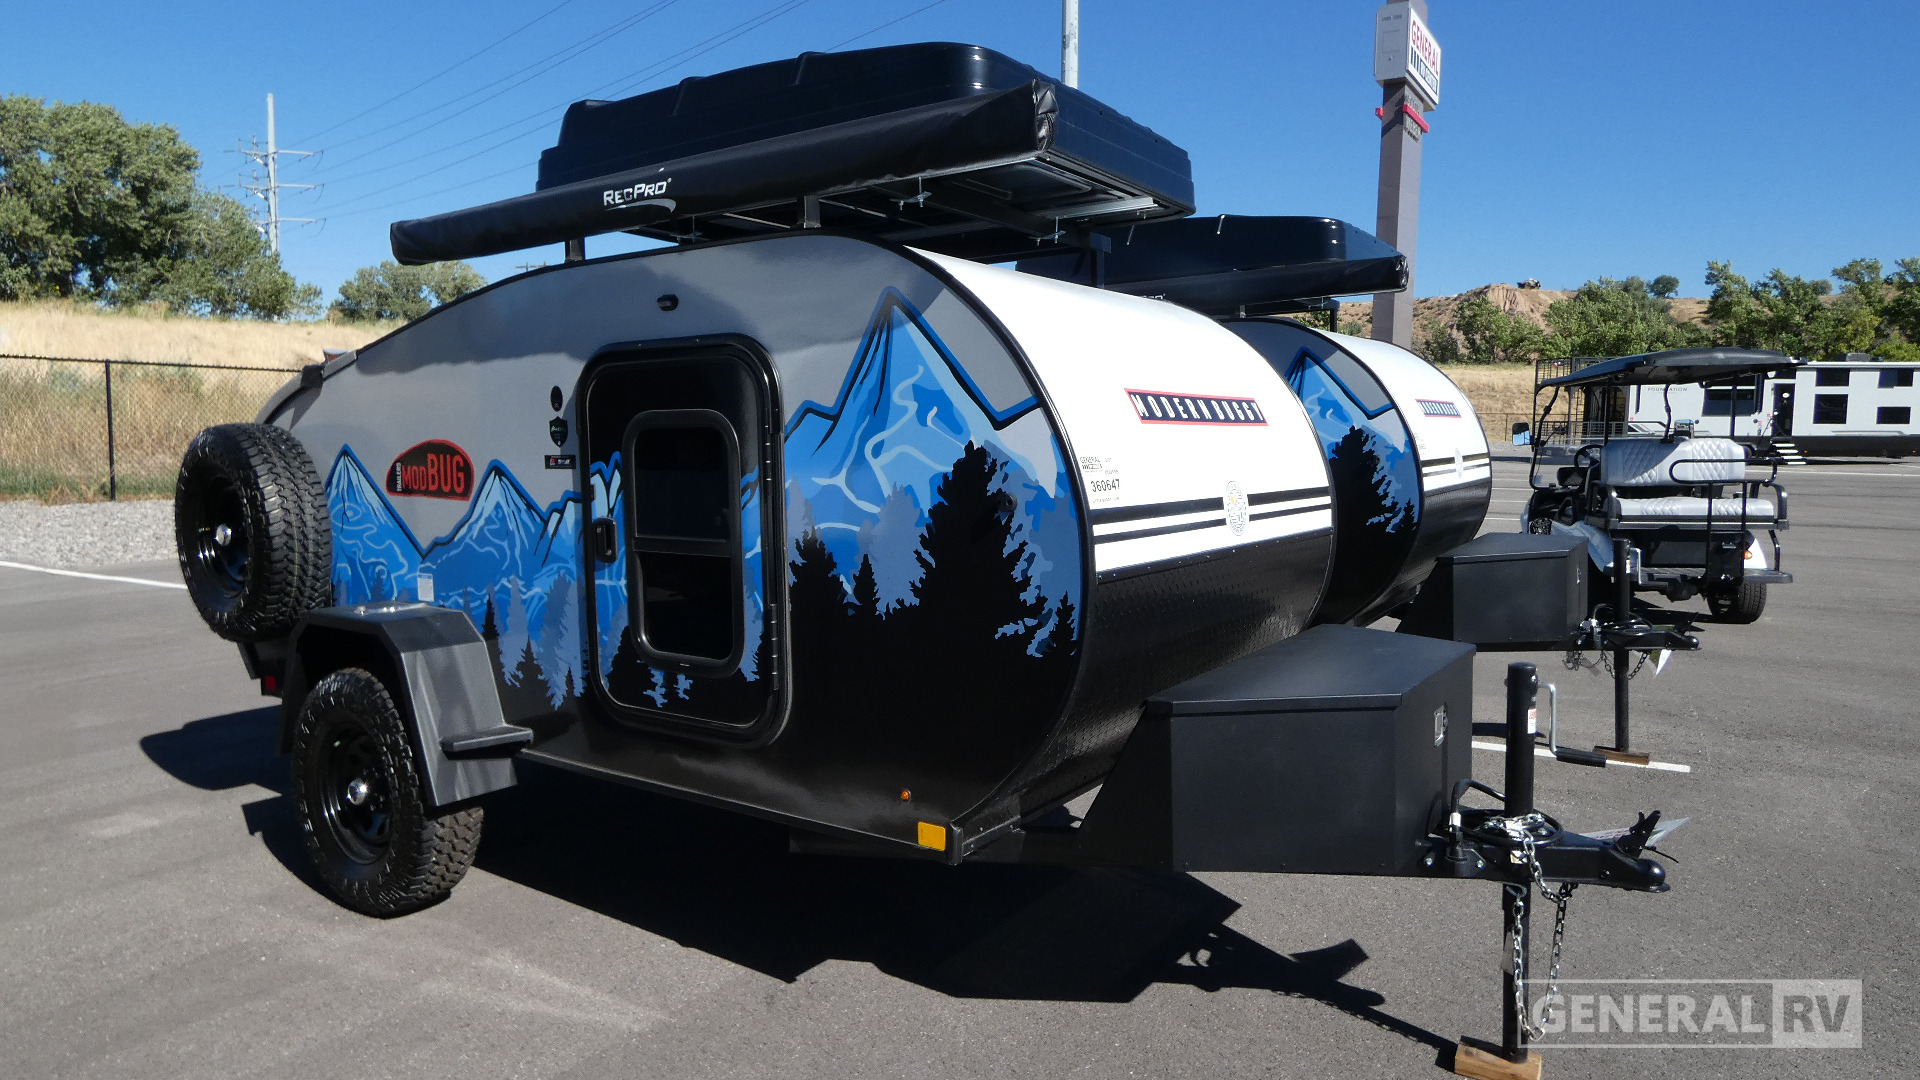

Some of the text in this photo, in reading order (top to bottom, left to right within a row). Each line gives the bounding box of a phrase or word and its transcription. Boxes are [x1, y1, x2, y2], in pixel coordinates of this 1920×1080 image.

[1411, 20, 1439, 76] GENERAL
[1130, 394, 1264, 421] MODERN BUGGY
[1090, 478, 1120, 493] 360647
